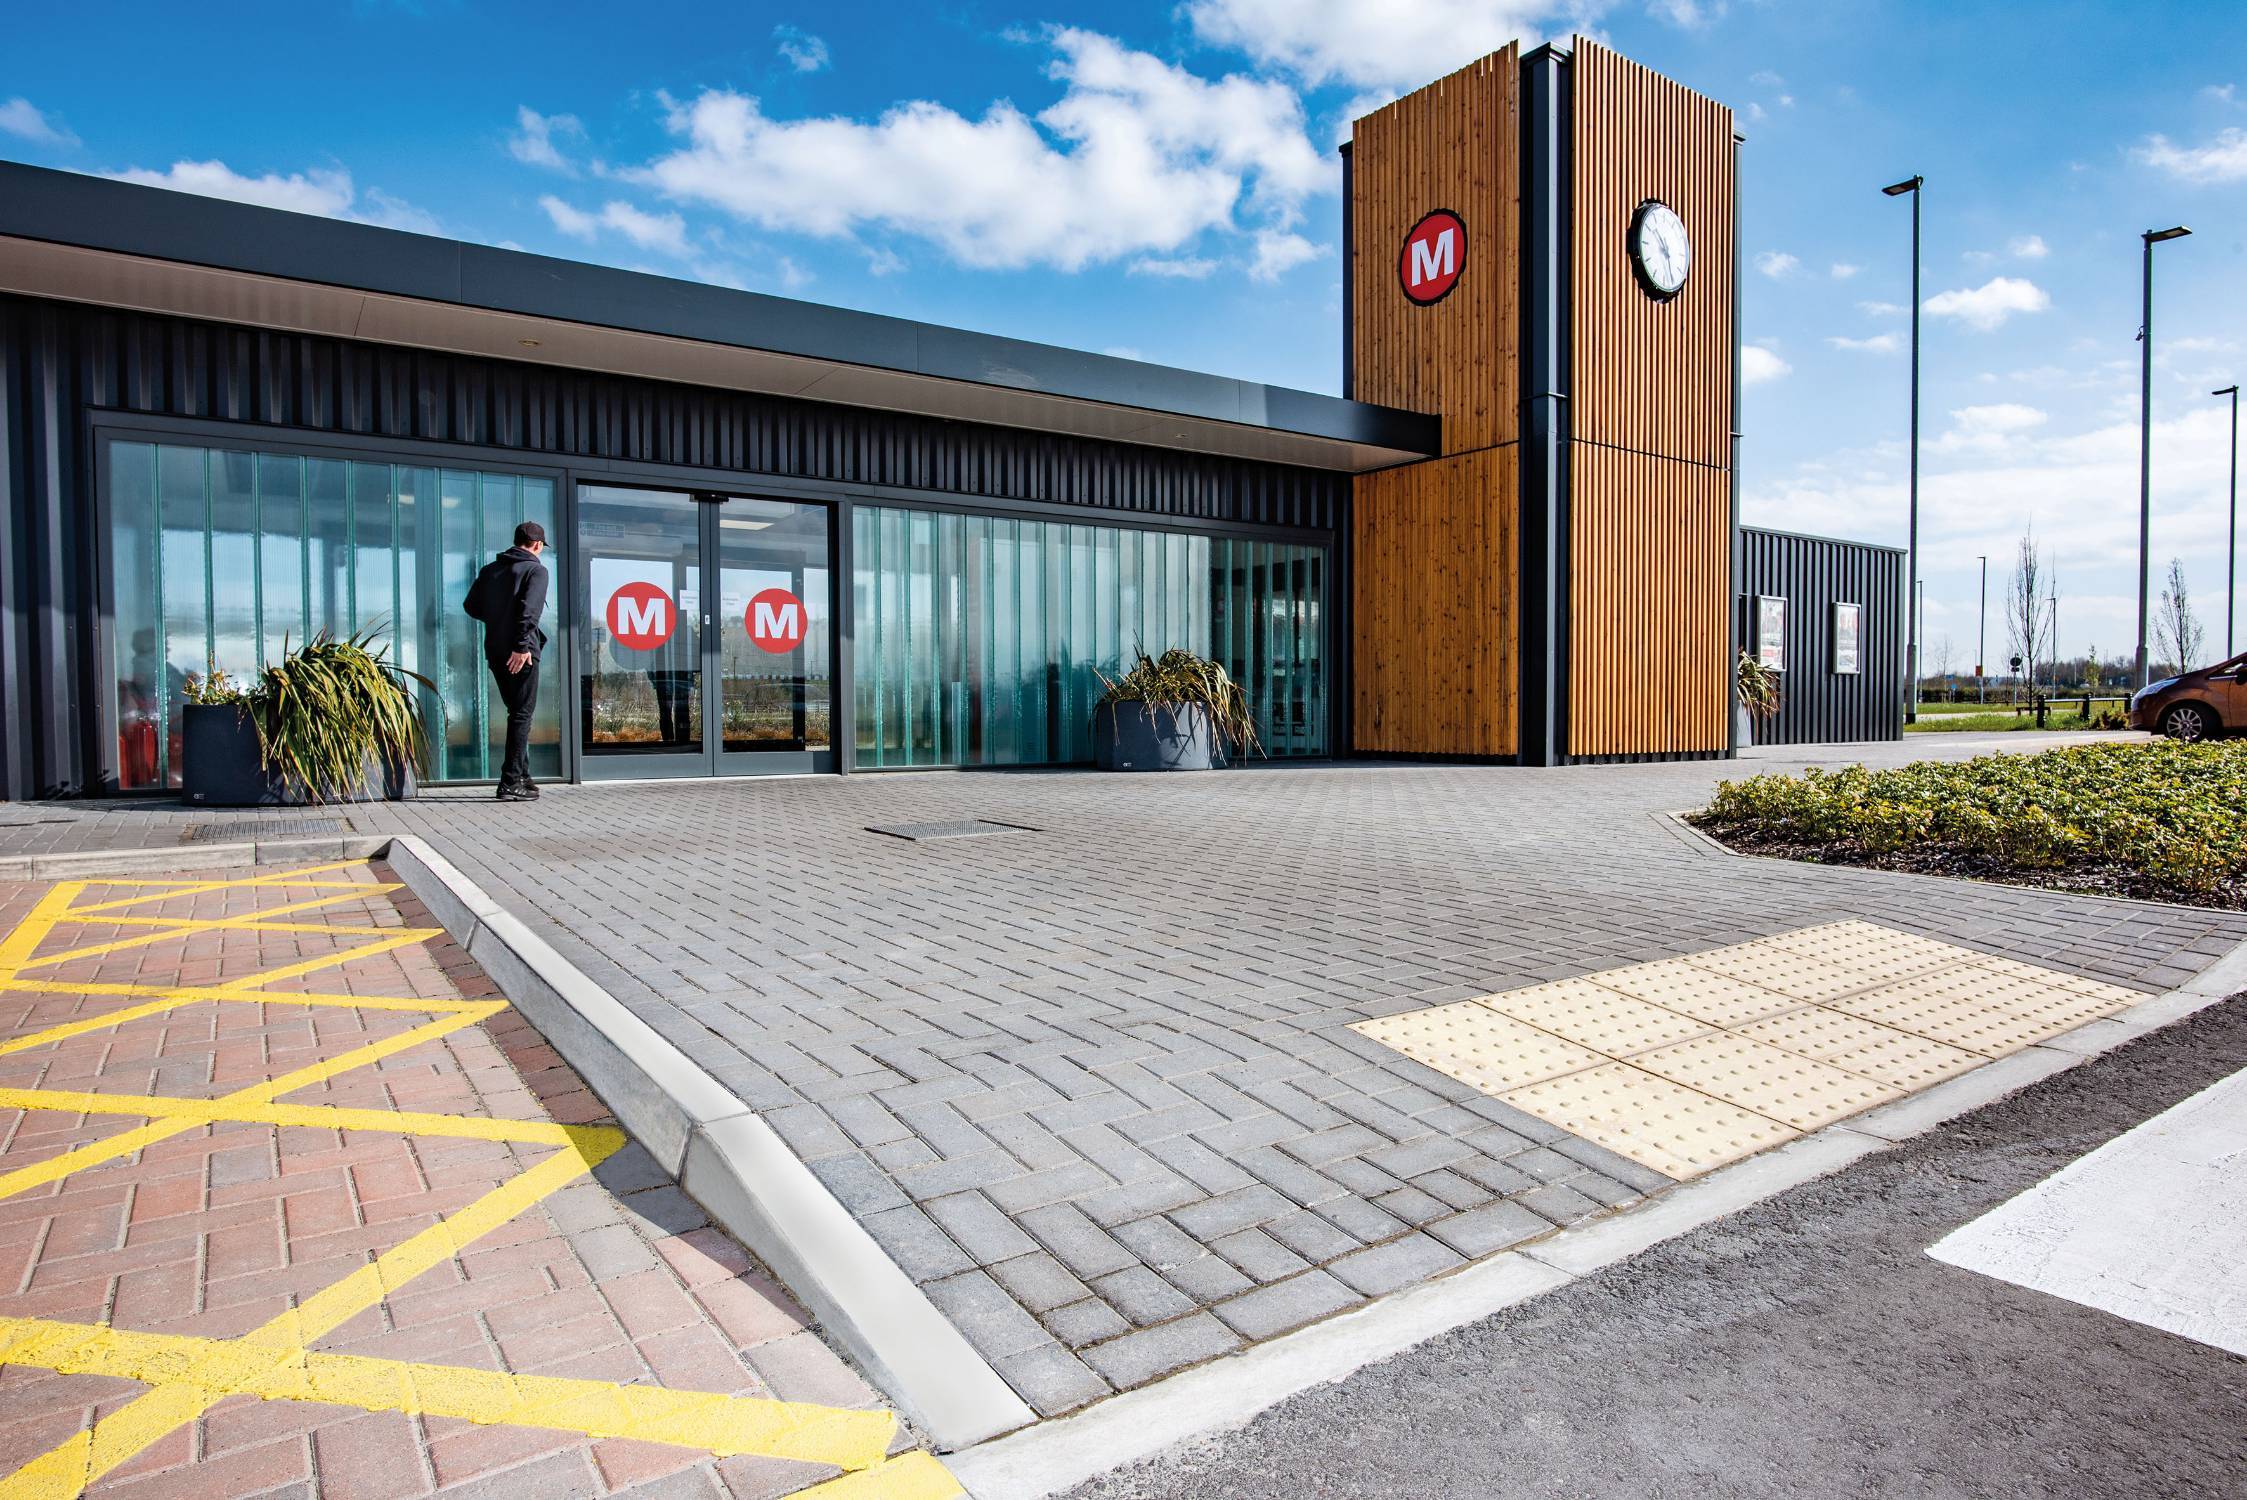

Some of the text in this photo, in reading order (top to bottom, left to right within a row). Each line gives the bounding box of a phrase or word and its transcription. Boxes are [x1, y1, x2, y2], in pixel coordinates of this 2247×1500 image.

[1411, 227, 1454, 287] M
[617, 596, 666, 636] M
[754, 602, 798, 639] M
